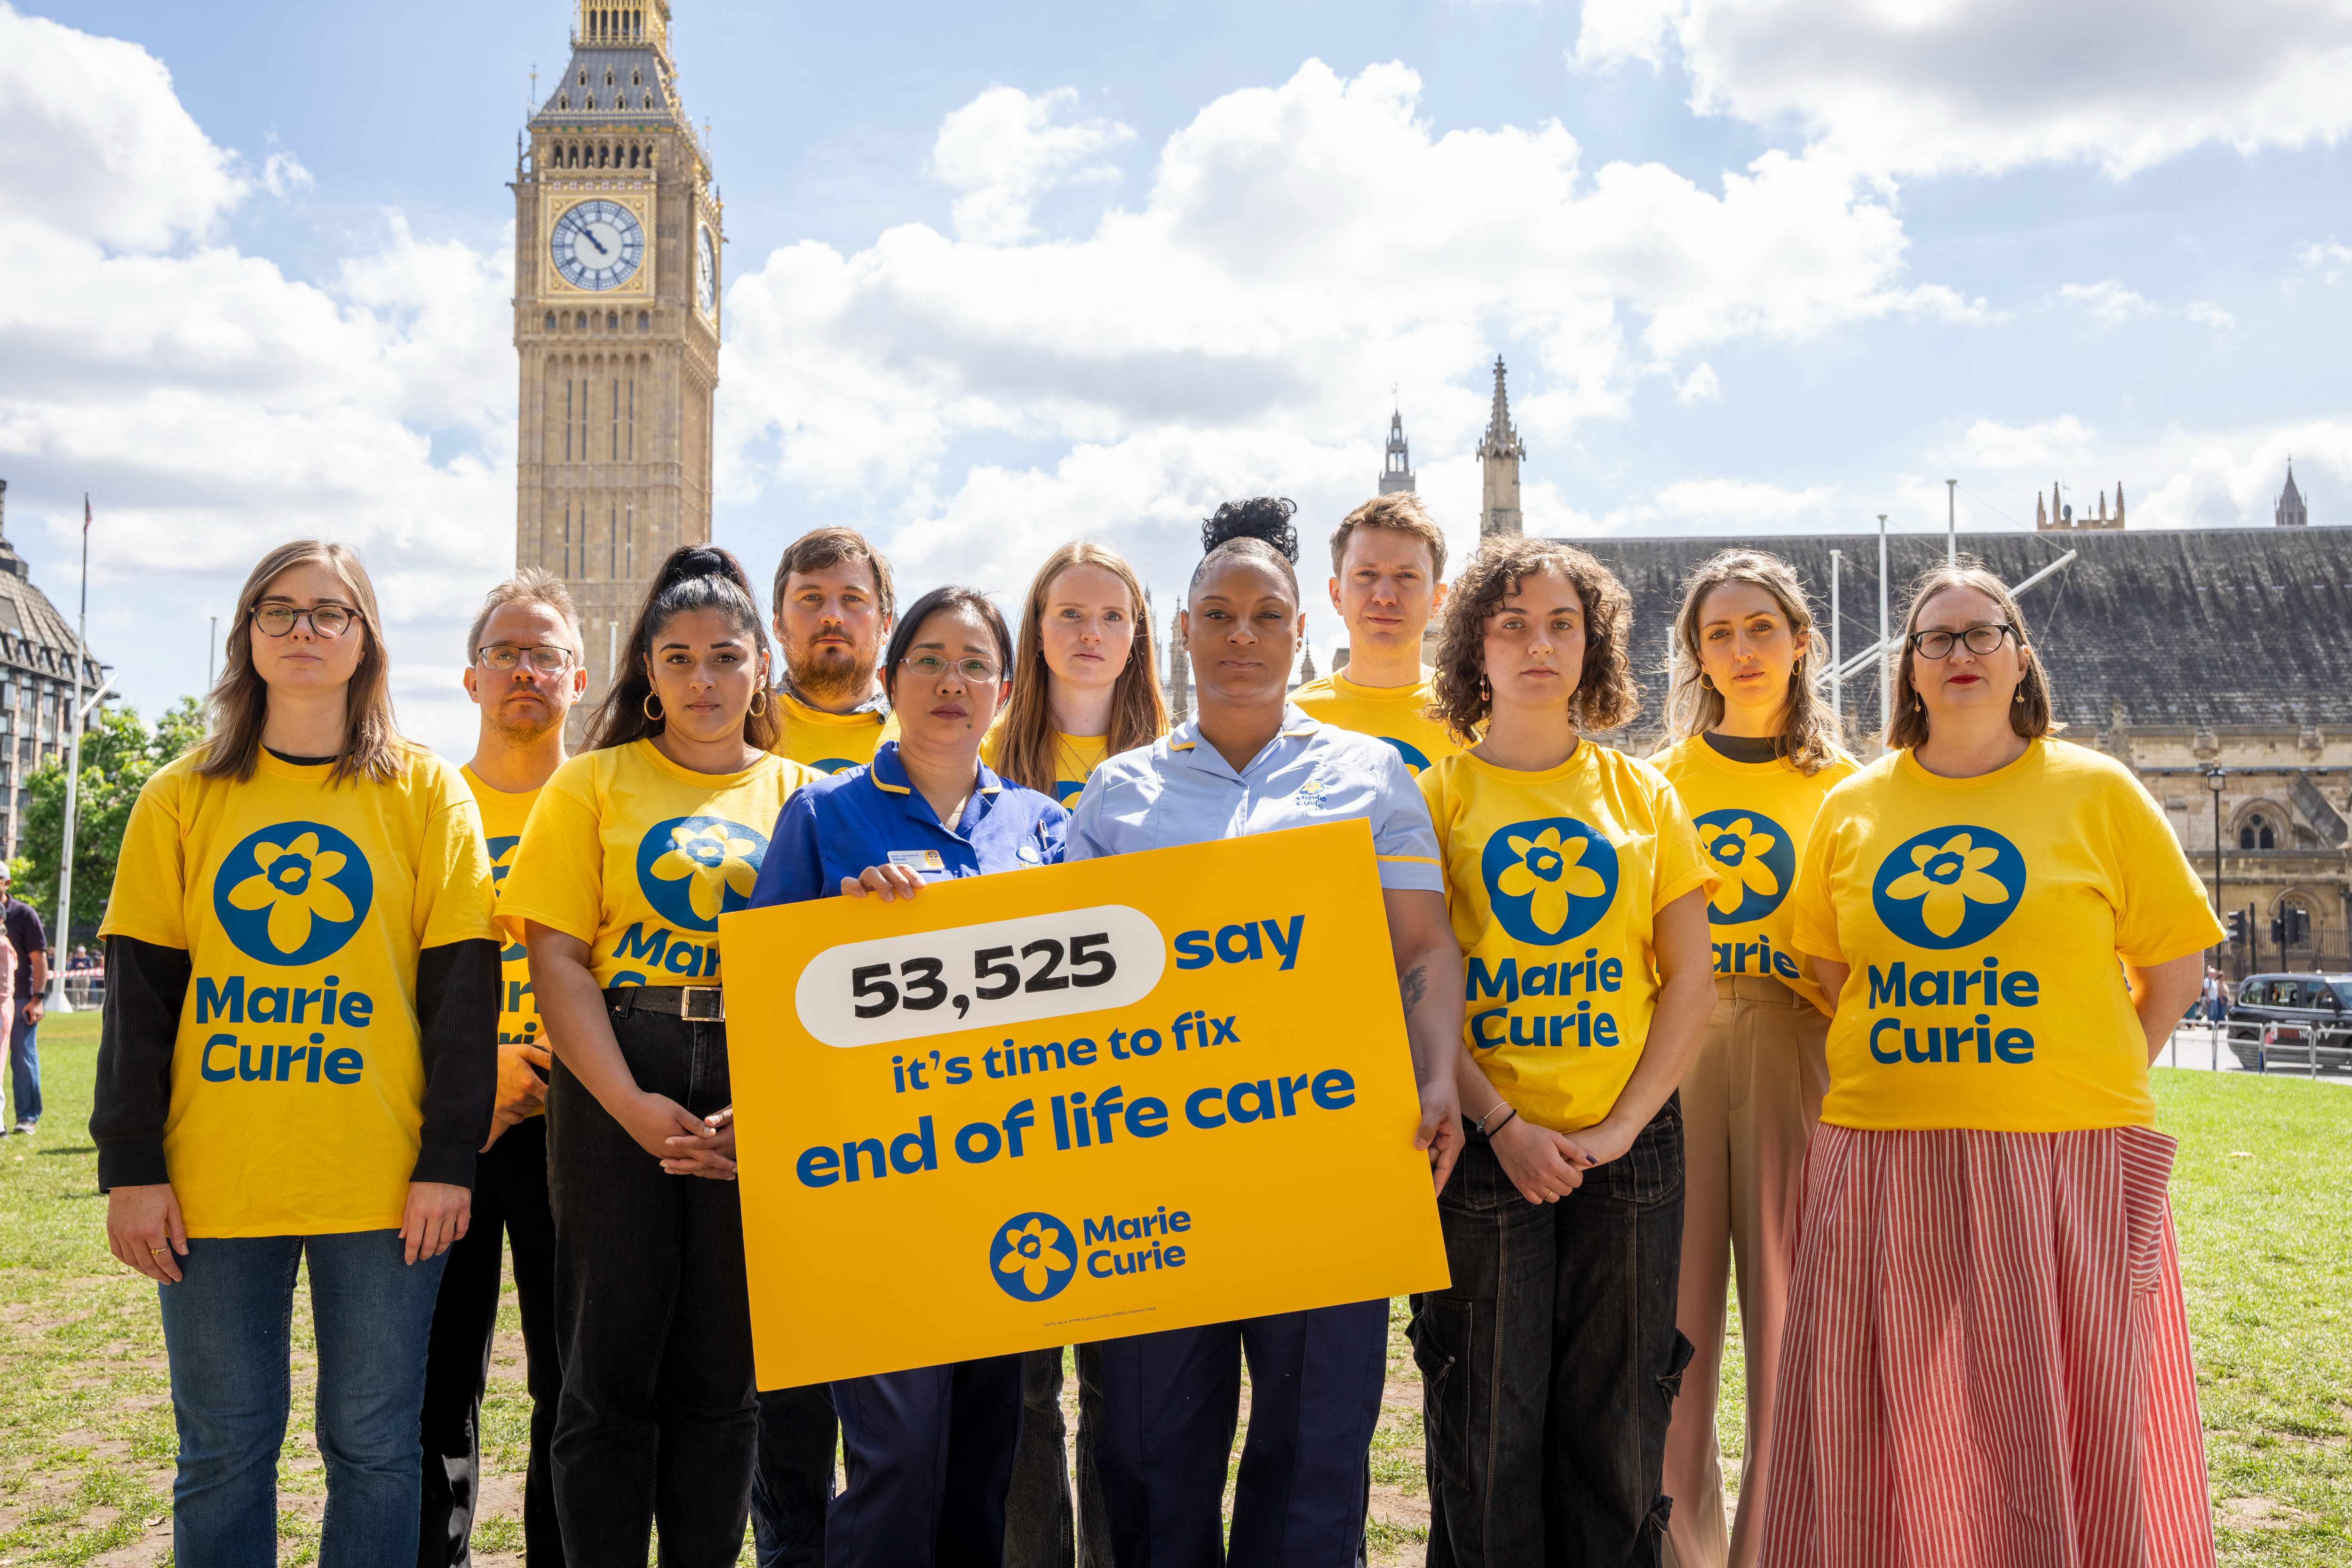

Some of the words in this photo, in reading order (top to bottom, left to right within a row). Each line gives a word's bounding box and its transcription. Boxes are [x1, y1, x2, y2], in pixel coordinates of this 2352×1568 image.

[612, 922, 721, 977] Mar
[852, 932, 1116, 1019] 53,525
[1175, 915, 1304, 970] say
[1466, 948, 1622, 1002] Marie
[1711, 934, 1800, 979] arie
[197, 975, 373, 1028] Marie
[1868, 956, 2039, 1009] Marie
[1471, 1001, 1620, 1049] Curie
[1870, 1014, 2034, 1063] Curie
[201, 1033, 363, 1084] Curie
[892, 1051, 972, 1093] it's
[982, 1038, 1097, 1079] time
[1108, 1029, 1162, 1059] to
[1172, 1011, 1240, 1051] fix
[796, 1115, 938, 1188] end
[954, 1098, 1034, 1163] of
[1051, 1085, 1168, 1150] life
[1185, 1069, 1355, 1129] care
[1083, 1206, 1191, 1246] Marie
[1087, 1241, 1186, 1278] Curie
